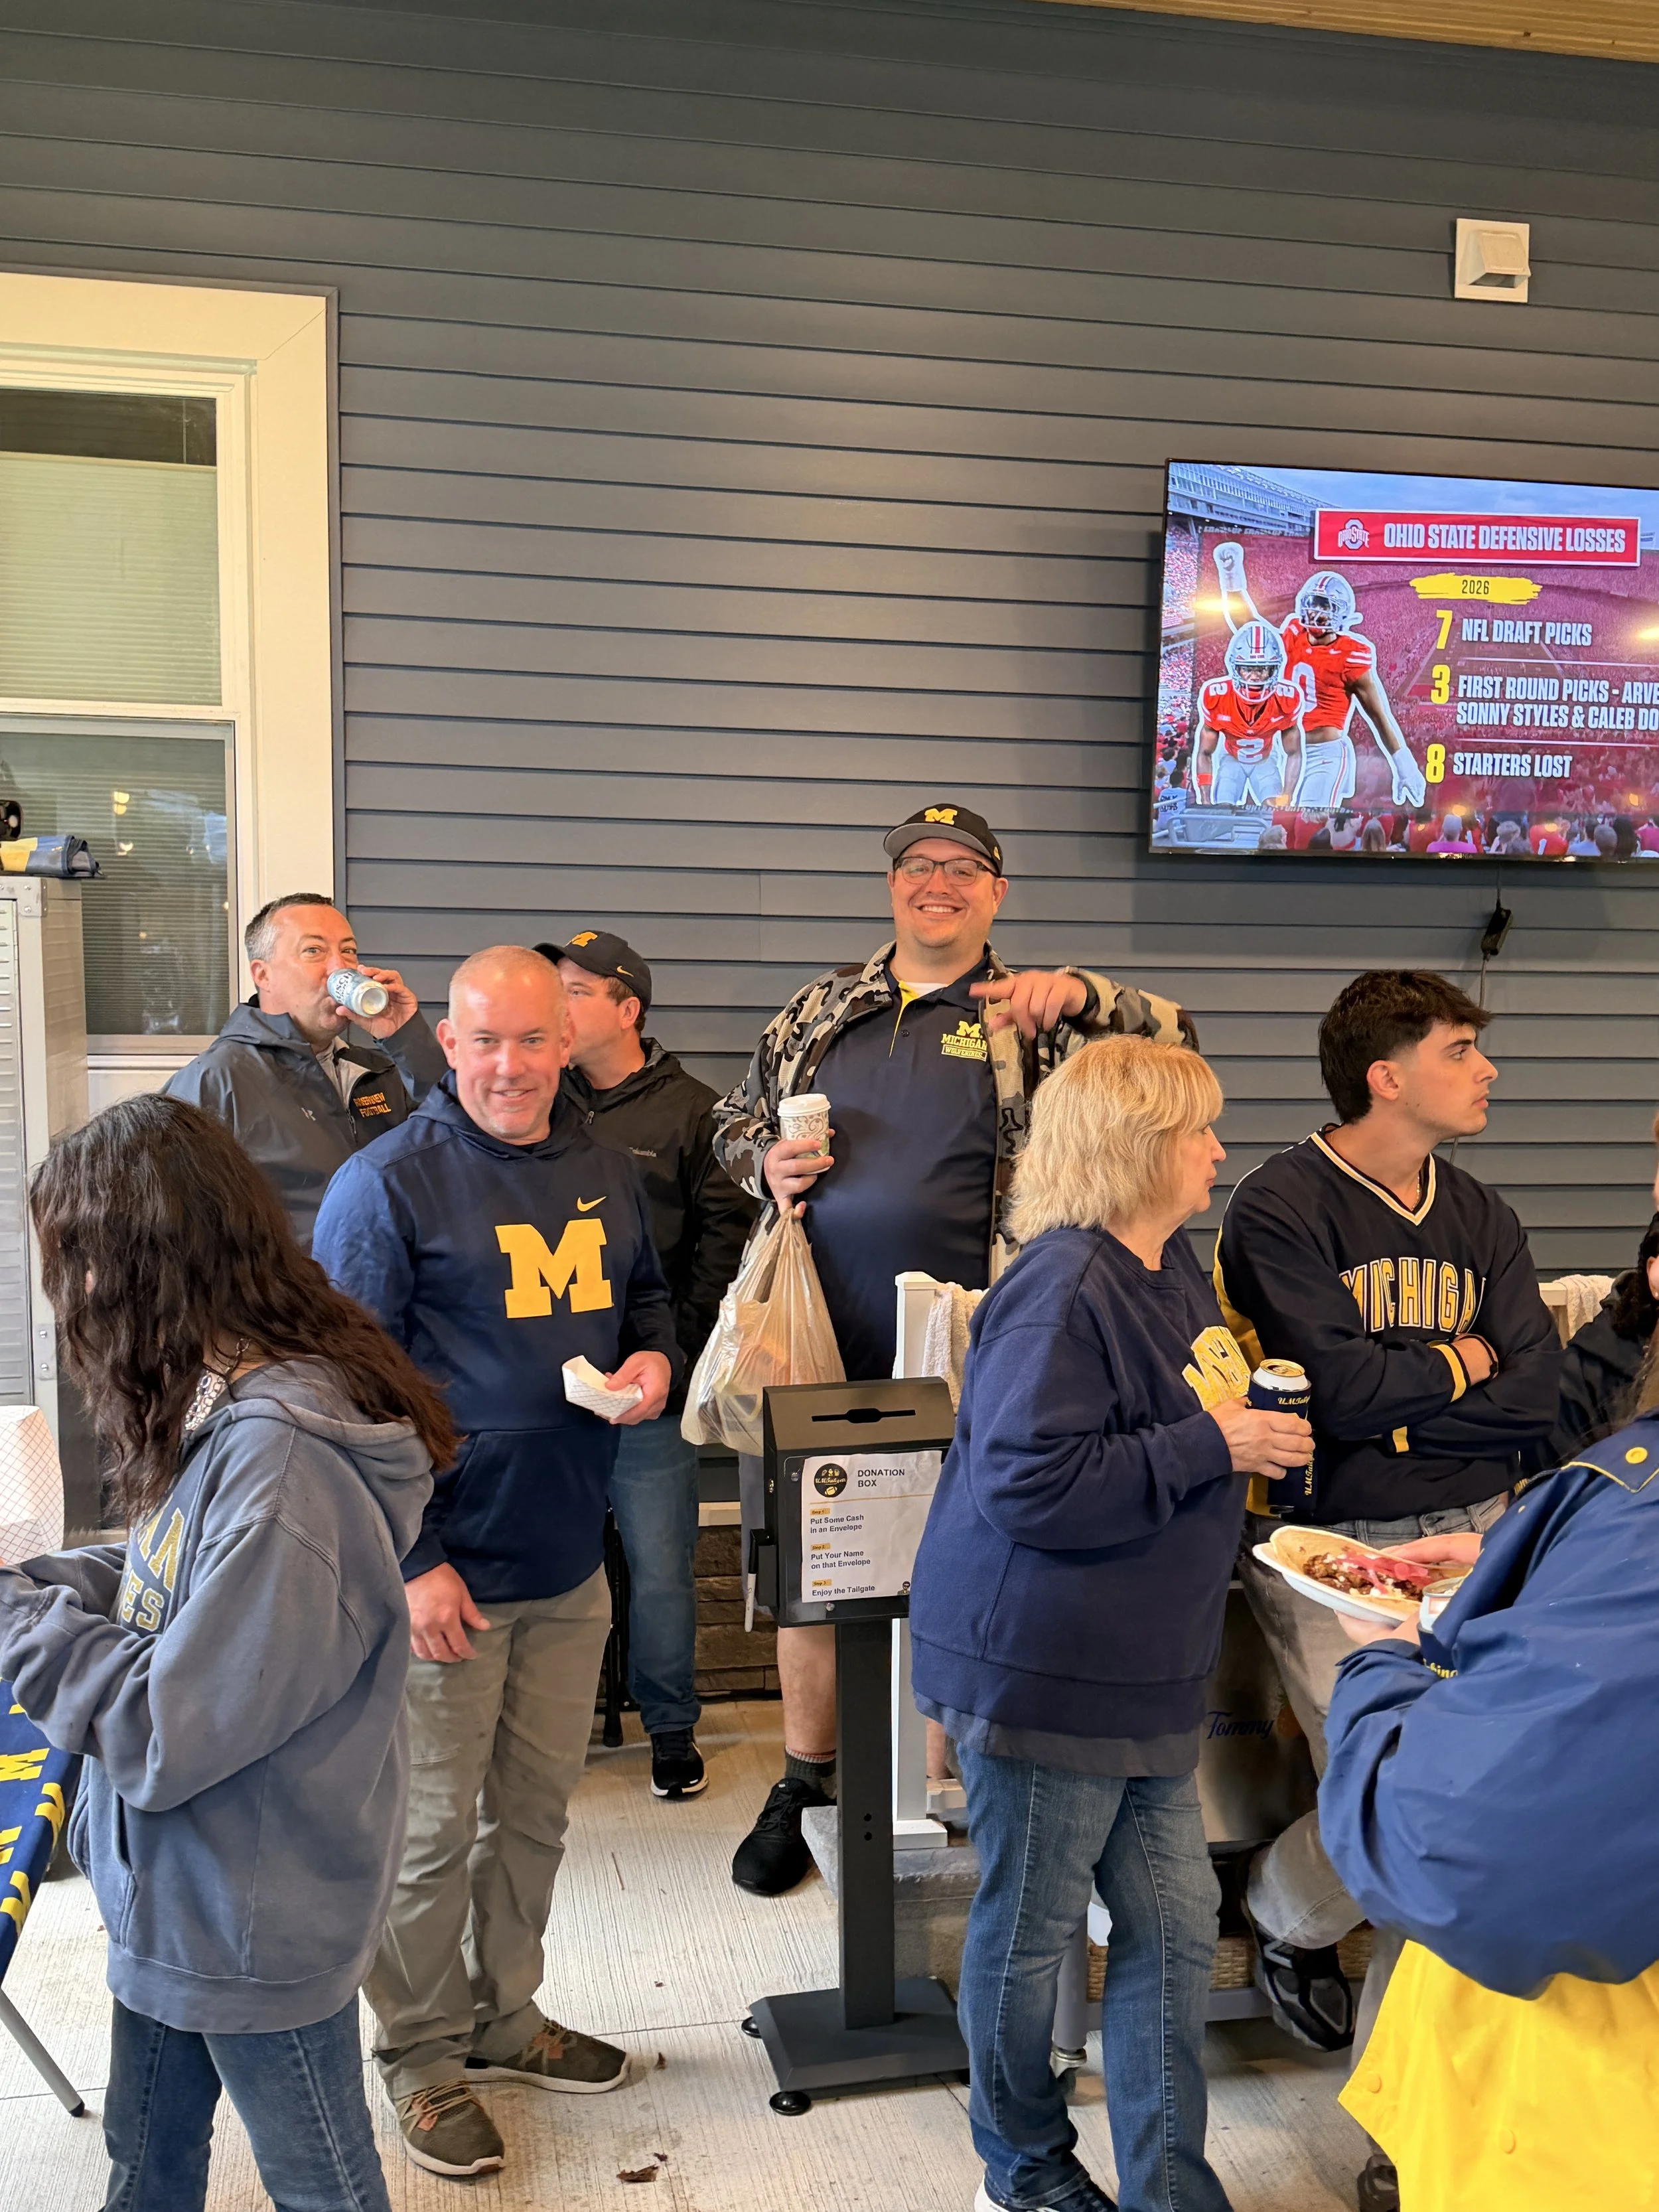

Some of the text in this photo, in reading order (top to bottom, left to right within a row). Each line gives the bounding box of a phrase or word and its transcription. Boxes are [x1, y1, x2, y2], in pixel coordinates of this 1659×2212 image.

[1384, 523, 1625, 553] OHIO STATE DEFENSIVE LOSSES
[1462, 579, 1490, 595] 2026
[1436, 609, 1593, 650] 7 NFL DRAFT PICKS
[1431, 664, 1450, 704] 3
[1458, 674, 1503, 699] FIRST
[1505, 676, 1559, 701] ROUND
[1562, 679, 1609, 703] PICKS
[1621, 681, 1659, 705] ARVE
[1456, 701, 1659, 731] SONNY STYLES & CALEB DO
[1236, 738, 1264, 763] 2
[1425, 743, 1573, 783] 8 STARTERS LOST
[924, 808, 958, 825] M
[956, 1020, 981, 1038] M
[945, 1046, 983, 1059] WOLVERINES
[359, 1103, 392, 1118] FOOTBALL
[494, 1218, 613, 1319] M
[1339, 1256, 1486, 1335] MICHIGA
[857, 1469, 905, 1477] DONATION
[838, 1558, 871, 1567] Envelope
[1206, 1711, 1275, 1740] Tommy
